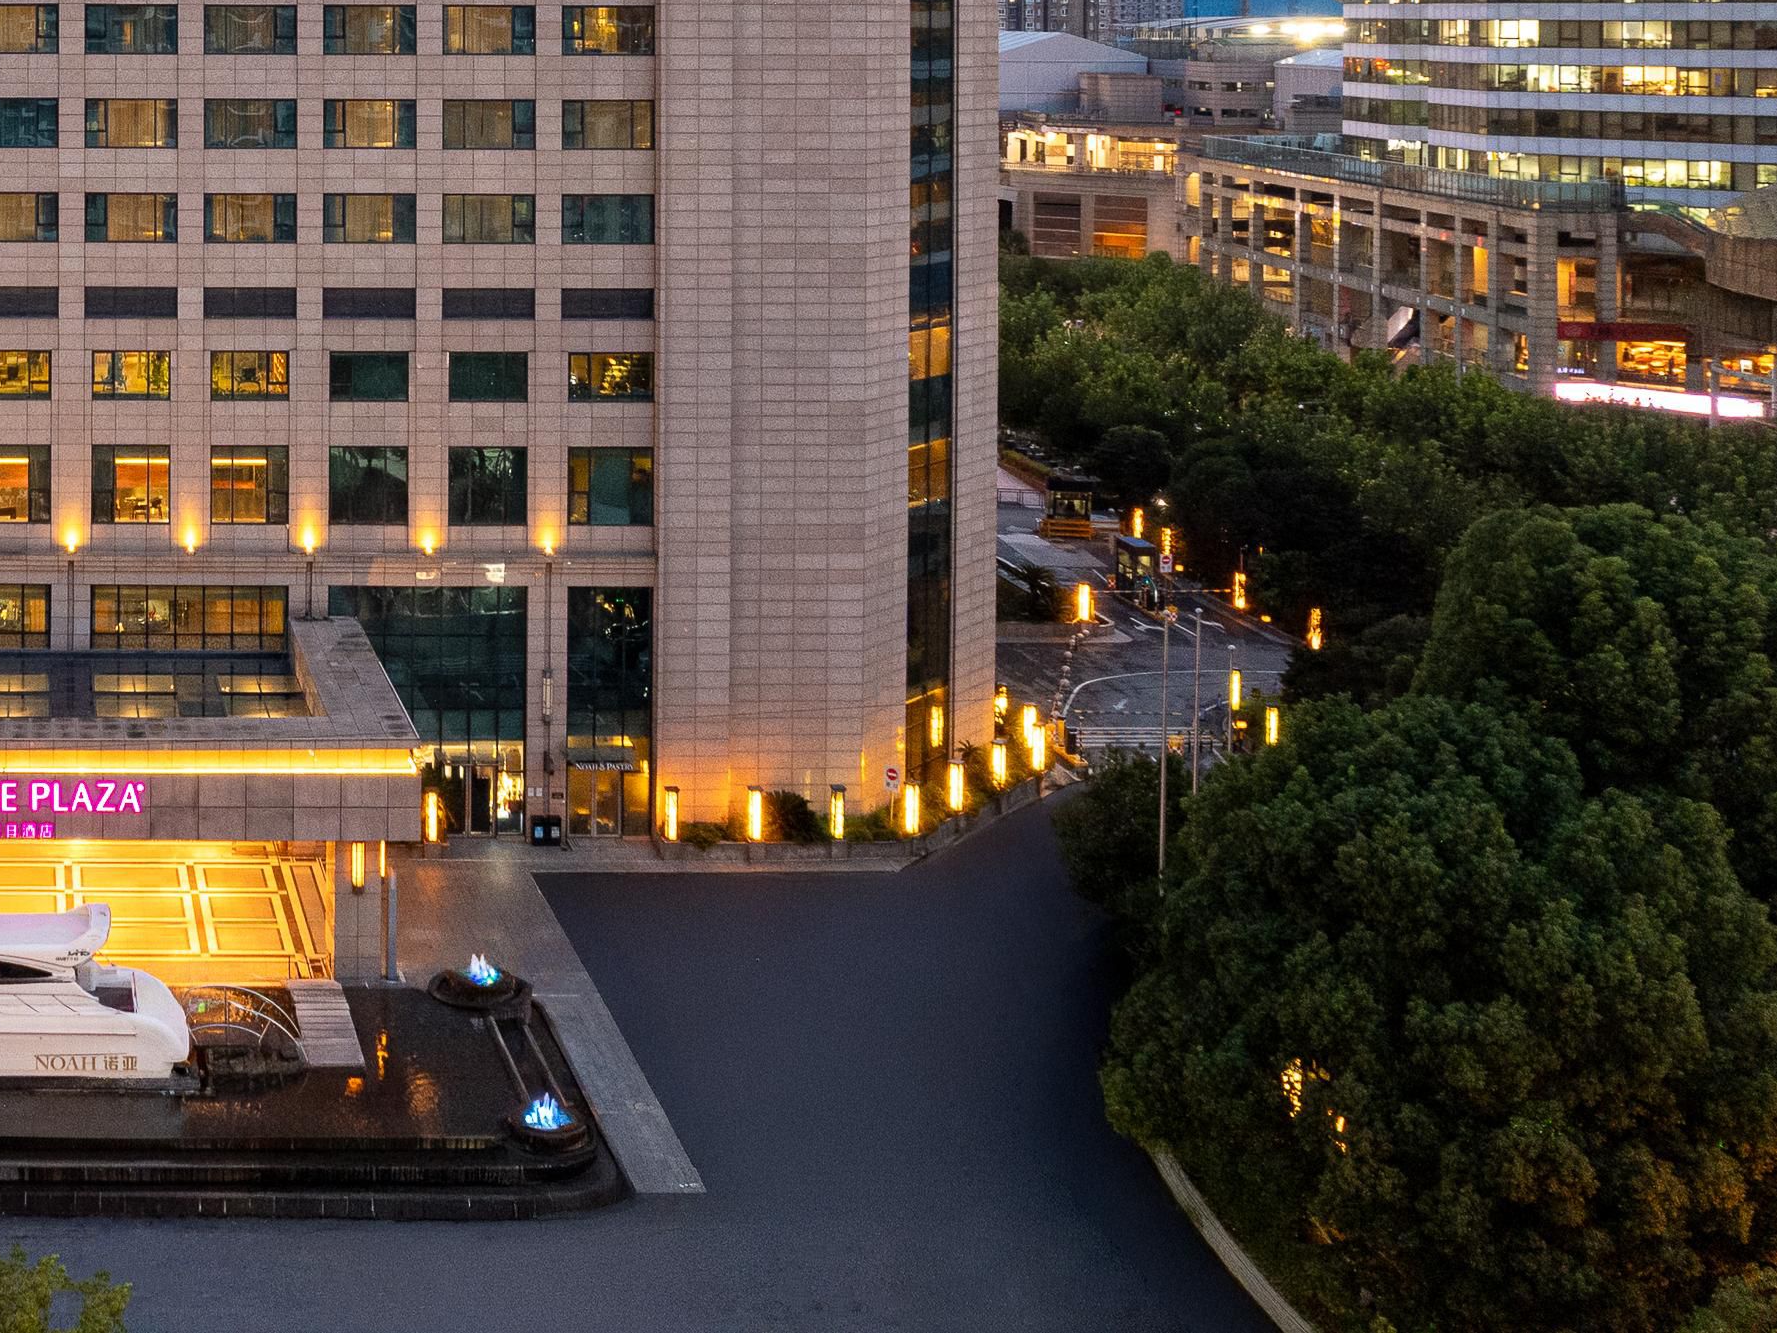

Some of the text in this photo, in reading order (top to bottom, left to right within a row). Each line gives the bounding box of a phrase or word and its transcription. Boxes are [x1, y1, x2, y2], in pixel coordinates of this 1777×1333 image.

[30, 781, 142, 813] PLAZA
[34, 1054, 138, 1071] NOAH 诺亚
